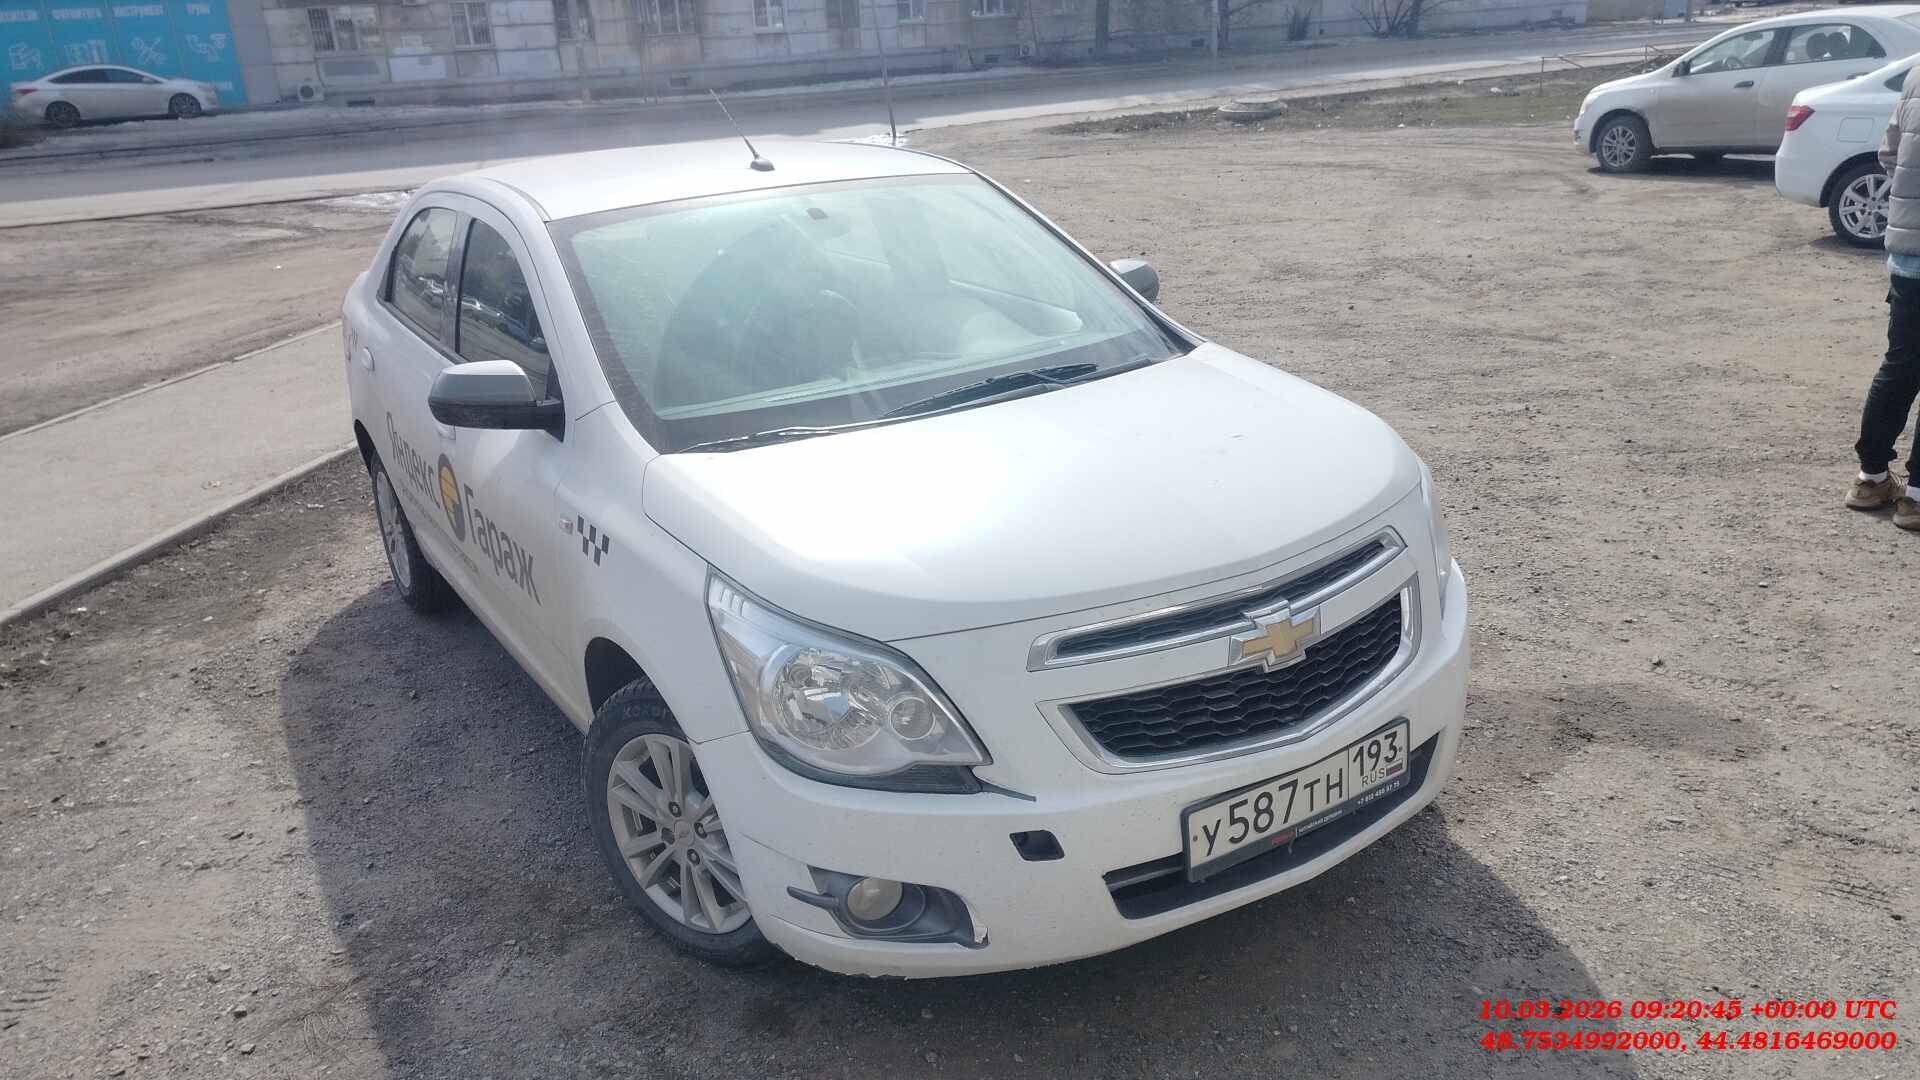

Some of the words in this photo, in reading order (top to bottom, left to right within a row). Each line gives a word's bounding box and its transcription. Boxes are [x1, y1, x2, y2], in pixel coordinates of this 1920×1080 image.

[386, 411, 441, 509] Яндекс
[464, 483, 541, 606] Гараж
[1202, 768, 1343, 857] У587ТН
[1352, 730, 1398, 777] 193
[1361, 767, 1386, 787] RUS
